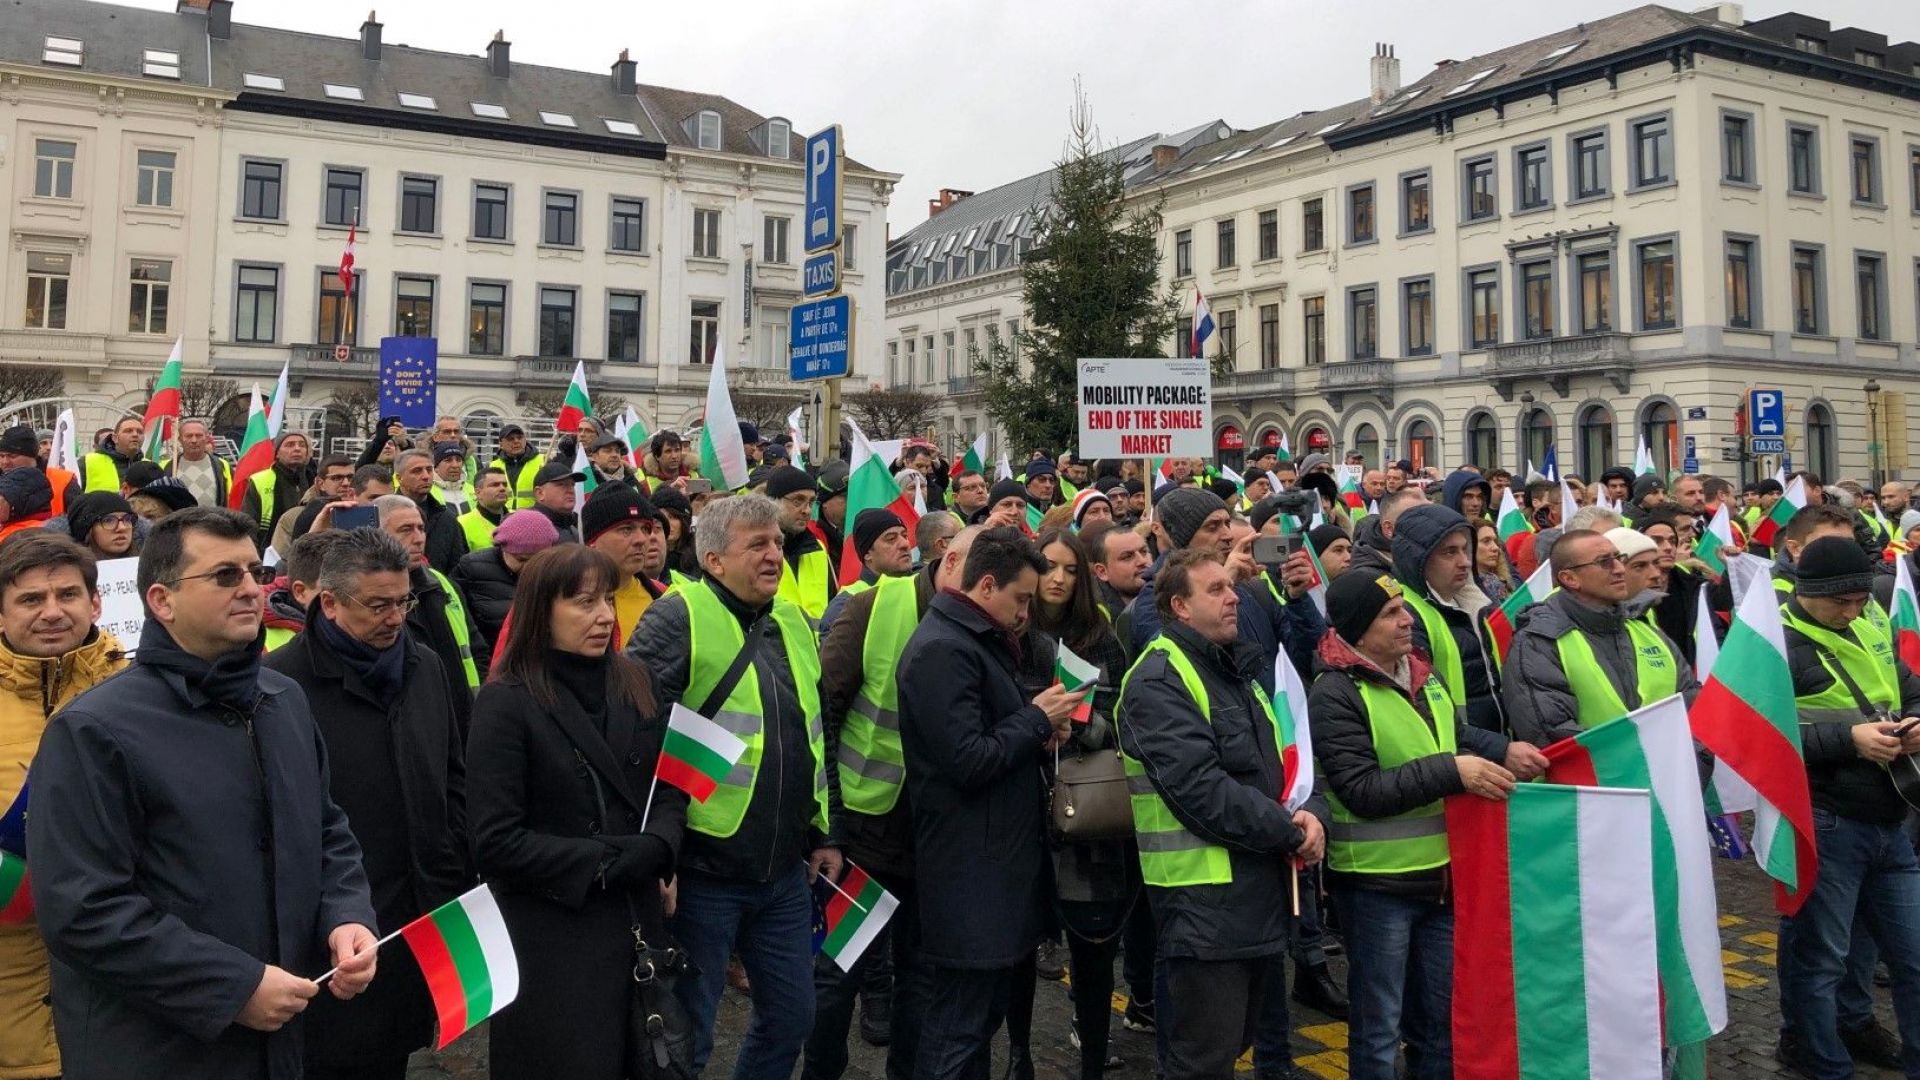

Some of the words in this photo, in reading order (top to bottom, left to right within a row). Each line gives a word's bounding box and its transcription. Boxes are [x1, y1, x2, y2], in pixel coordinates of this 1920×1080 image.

[812, 138, 830, 204] P
[806, 260, 834, 288] TAXIS
[802, 309, 814, 323] SAUF
[815, 307, 821, 320] LE
[823, 305, 836, 318] JEUDI
[805, 323, 821, 337] PARTIR
[821, 322, 828, 335] DE
[819, 340, 846, 355] DONDERDAG
[806, 359, 821, 373] VANAF
[1085, 365, 1106, 374] APTE
[394, 379, 423, 387] DIVIDE
[1083, 385, 1144, 405] MOBILITY
[1147, 385, 1207, 405] PACKAGE:
[1756, 393, 1776, 418] P
[1088, 410, 1113, 430] END
[1116, 410, 1132, 430] OF
[1134, 410, 1158, 429] THE
[1160, 410, 1203, 429] SINGLE
[1121, 434, 1172, 455] MARKET
[1687, 440, 1694, 455] P
[1754, 440, 1783, 451] TAXIS
